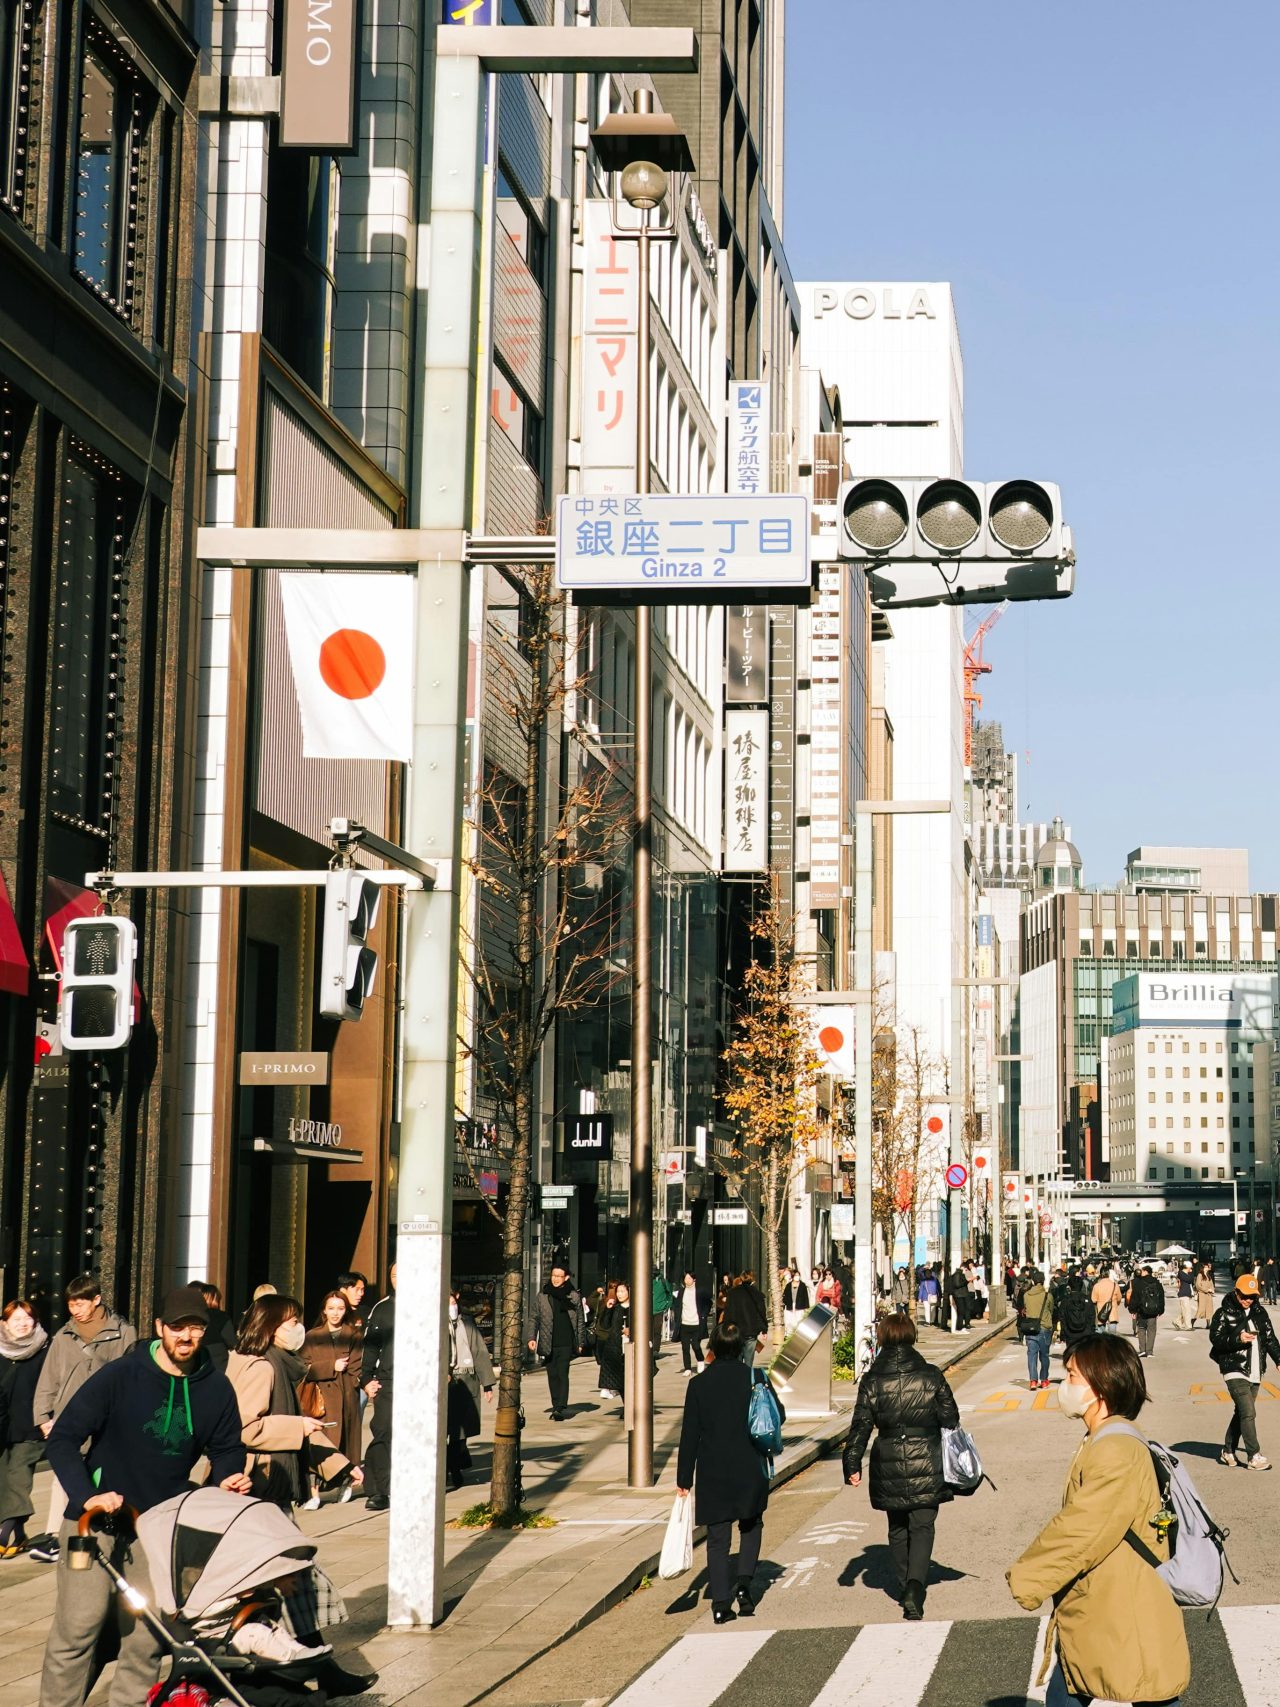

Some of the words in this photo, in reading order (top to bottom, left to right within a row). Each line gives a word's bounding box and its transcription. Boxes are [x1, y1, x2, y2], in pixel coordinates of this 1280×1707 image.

[813, 288, 936, 319] POLA
[595, 235, 629, 430] エニマリ
[575, 498, 643, 516] 中央区
[575, 519, 792, 556] 銀座二丁目
[641, 558, 703, 578] Ginza
[713, 558, 726, 577] 2
[732, 730, 760, 852] 椿屋珈琲店
[1148, 984, 1235, 1002] Brillia
[252, 1064, 317, 1073] I-PRIMO
[288, 1117, 342, 1147] I-PRIMO
[571, 1122, 602, 1148] dunhill
